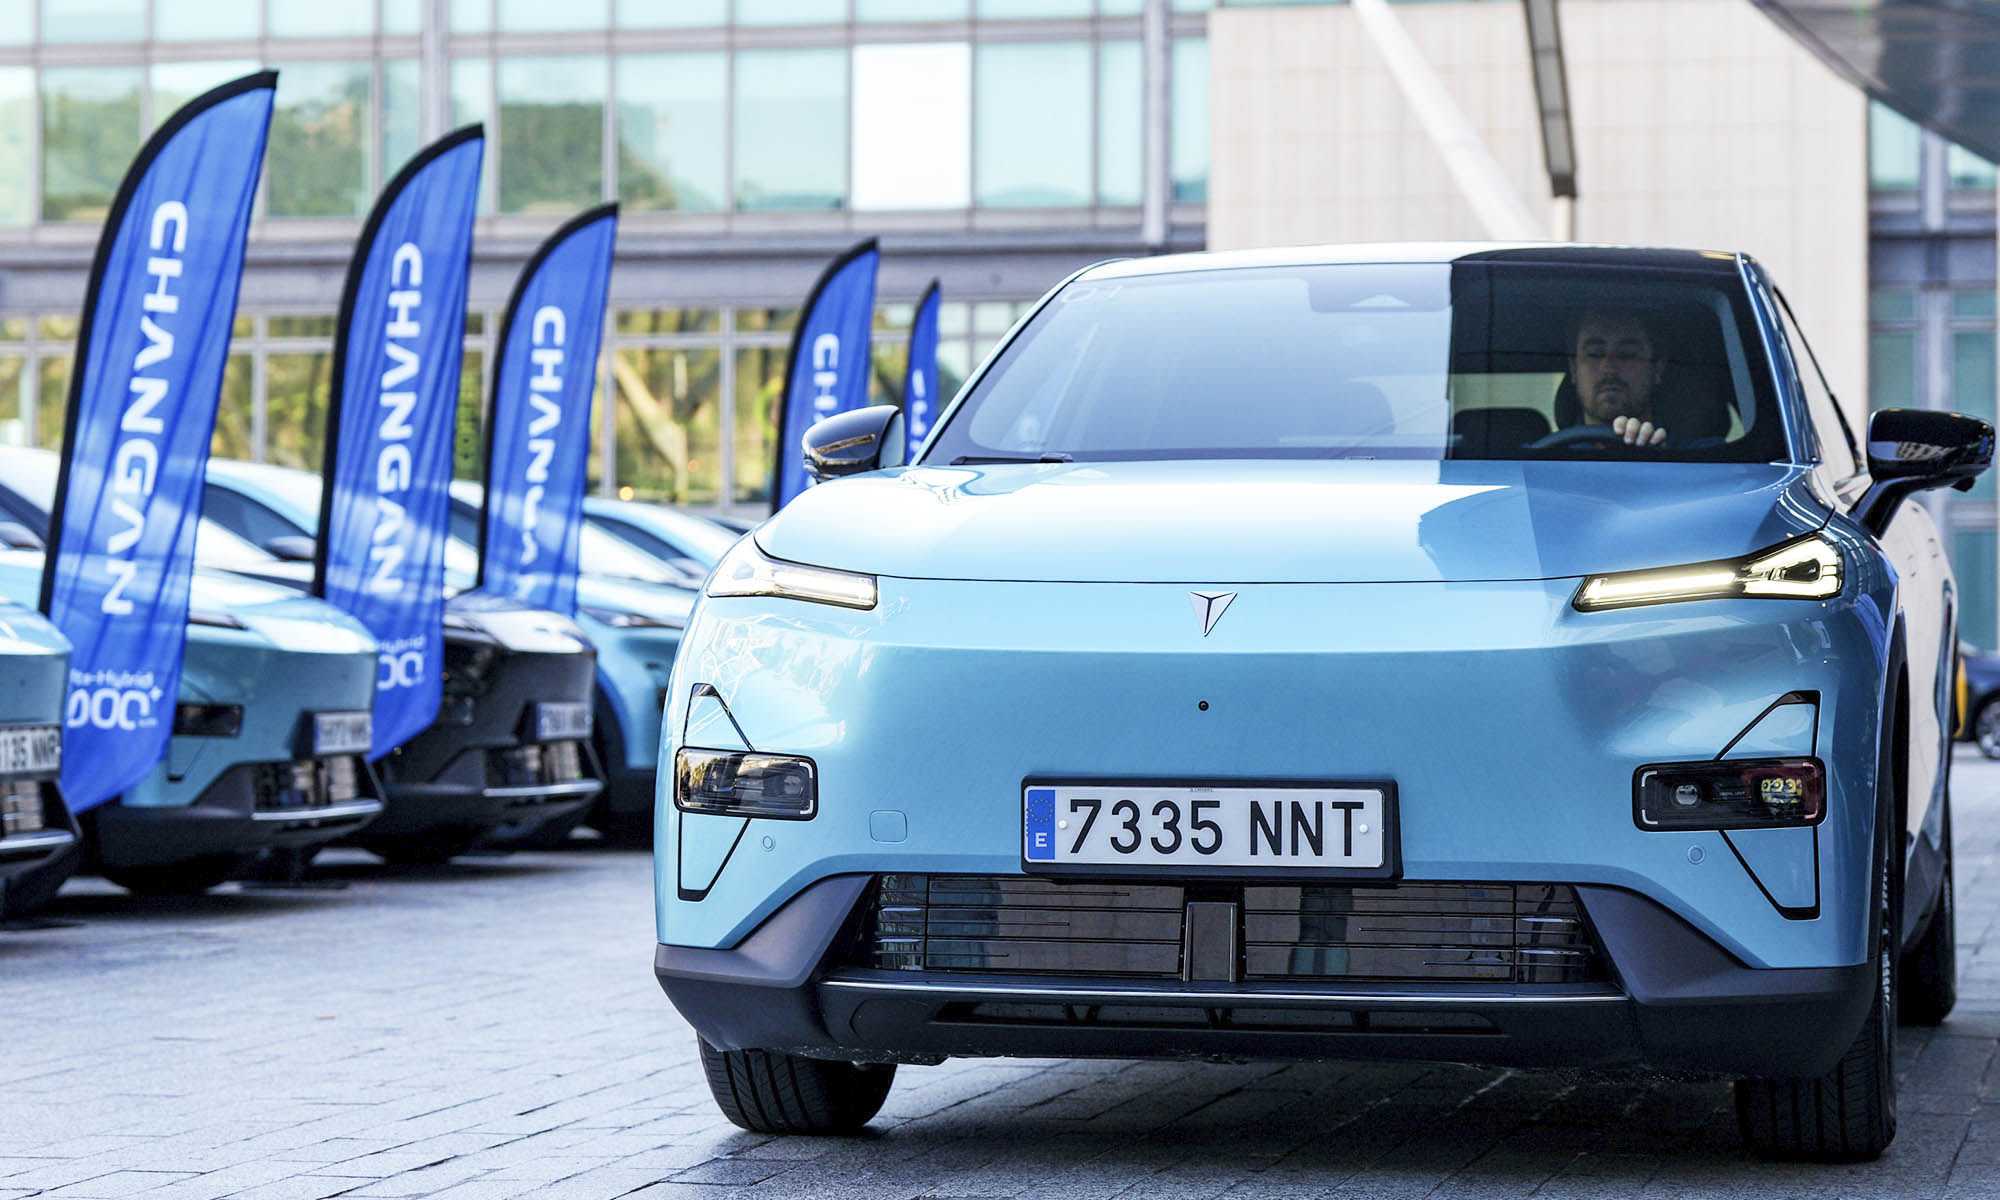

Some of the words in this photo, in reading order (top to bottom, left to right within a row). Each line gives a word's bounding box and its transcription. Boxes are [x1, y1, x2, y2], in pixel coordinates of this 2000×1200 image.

[102, 201, 188, 615] CHANGAN
[1035, 832, 1048, 848] E
[1070, 799, 1223, 855] 7335
[1250, 801, 1364, 857] NNT
